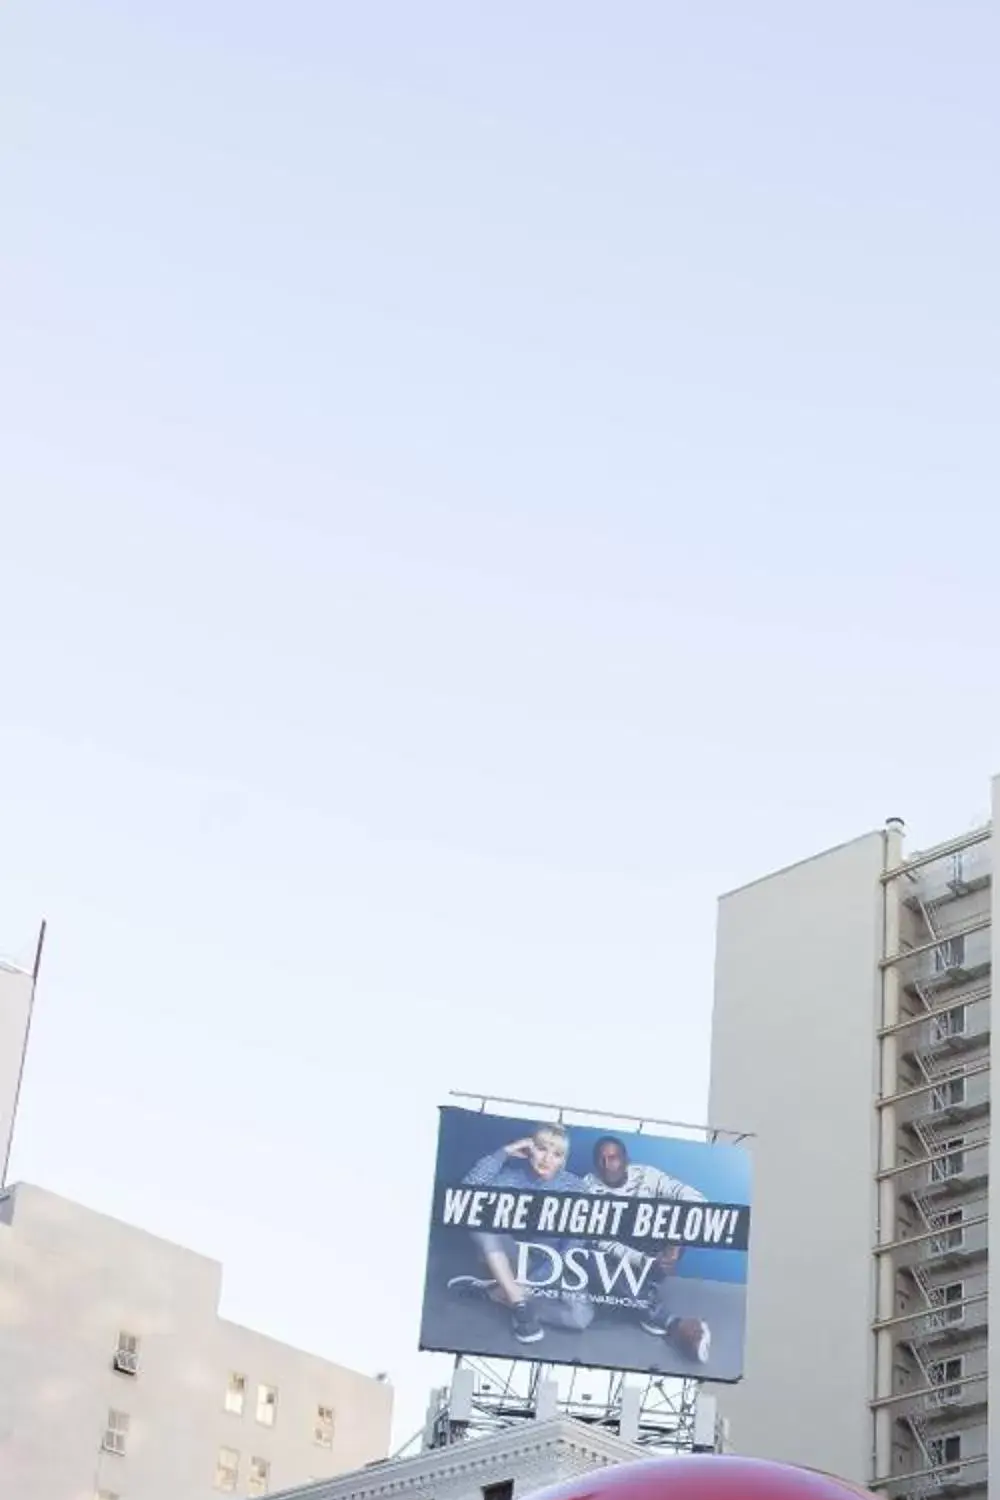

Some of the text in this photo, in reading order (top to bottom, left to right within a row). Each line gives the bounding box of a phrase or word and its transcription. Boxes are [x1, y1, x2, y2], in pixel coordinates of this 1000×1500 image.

[443, 1188, 739, 1244] WE'RE RIGHT BELOW!
[513, 1241, 656, 1298] DSW
